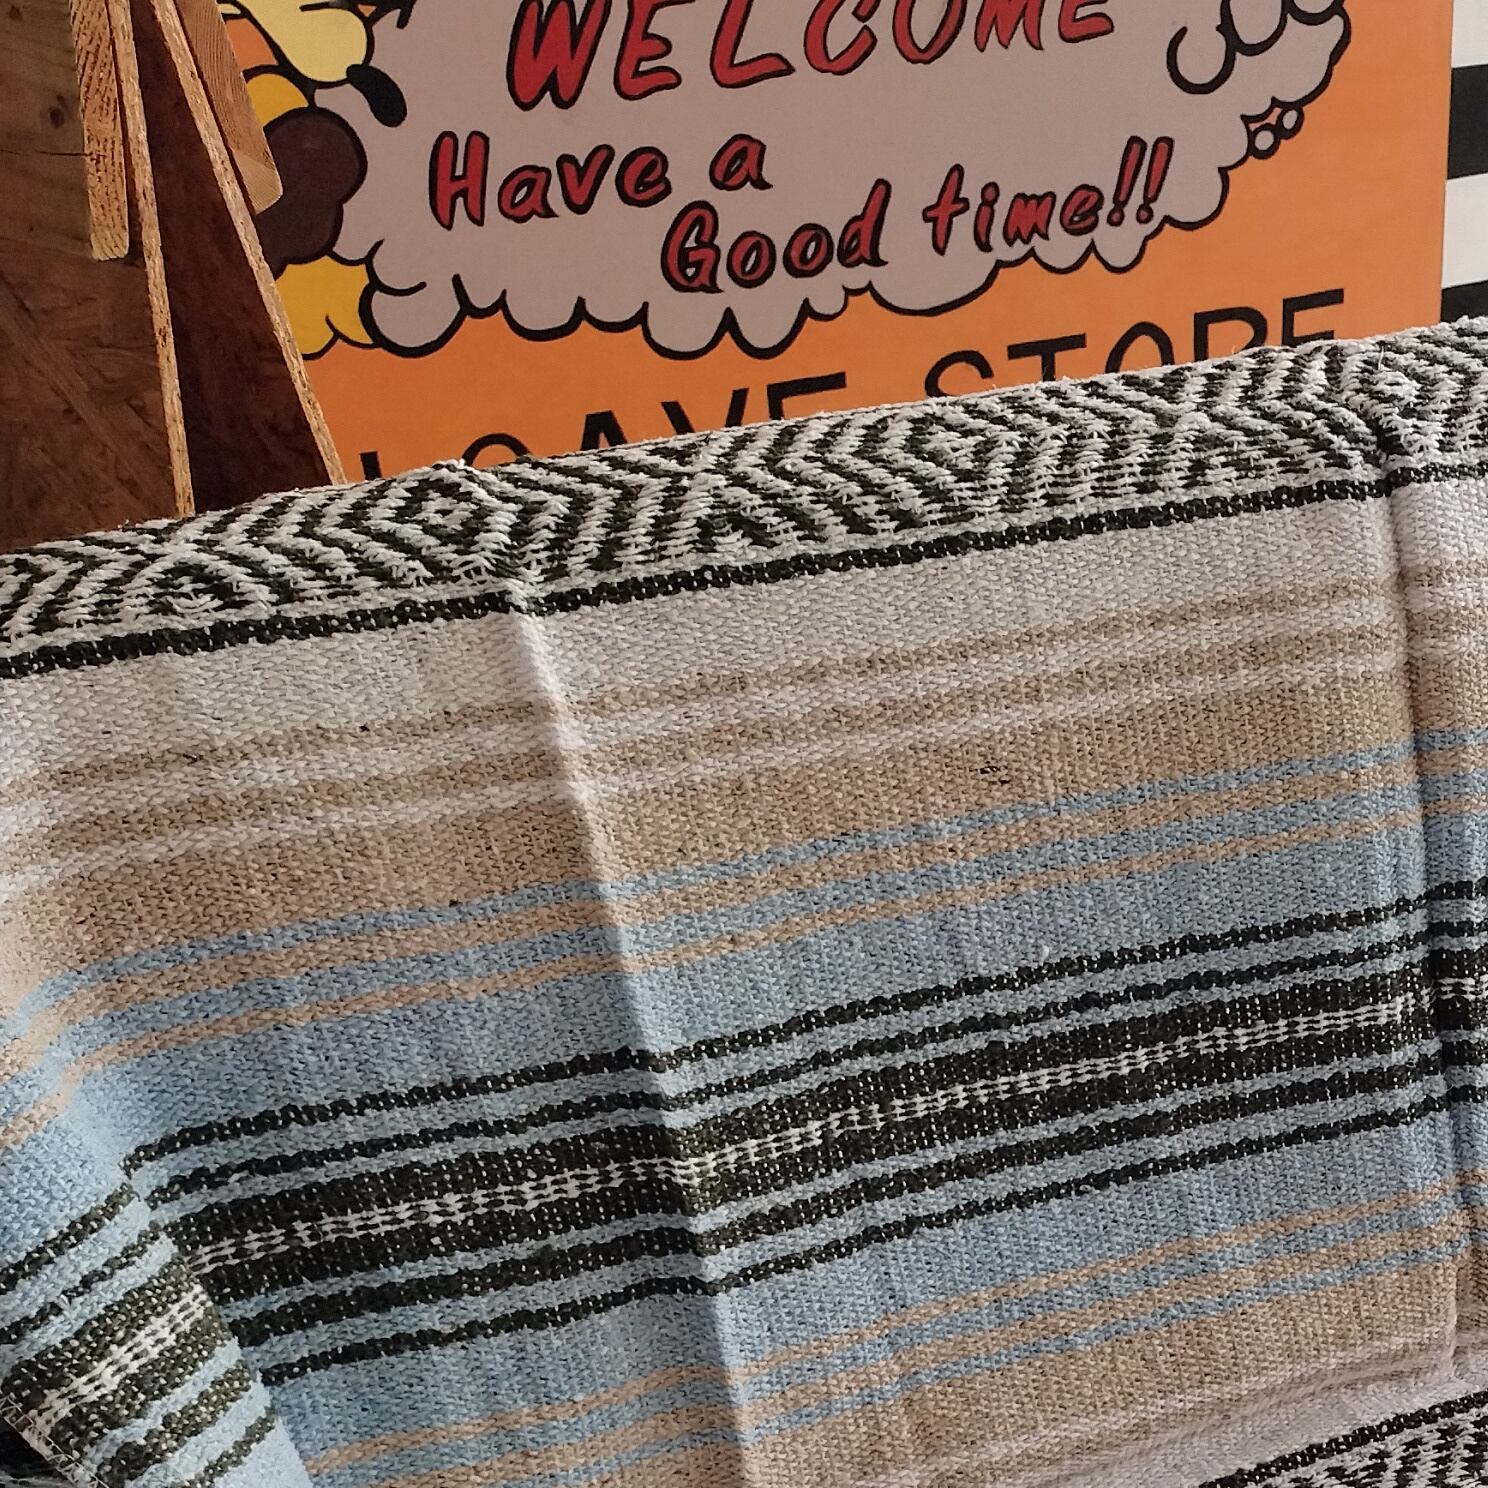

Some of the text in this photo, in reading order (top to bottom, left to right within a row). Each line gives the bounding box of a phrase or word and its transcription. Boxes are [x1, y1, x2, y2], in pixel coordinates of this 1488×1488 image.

[429, 130, 774, 231] Have a
[660, 135, 1175, 294] Good time!!
